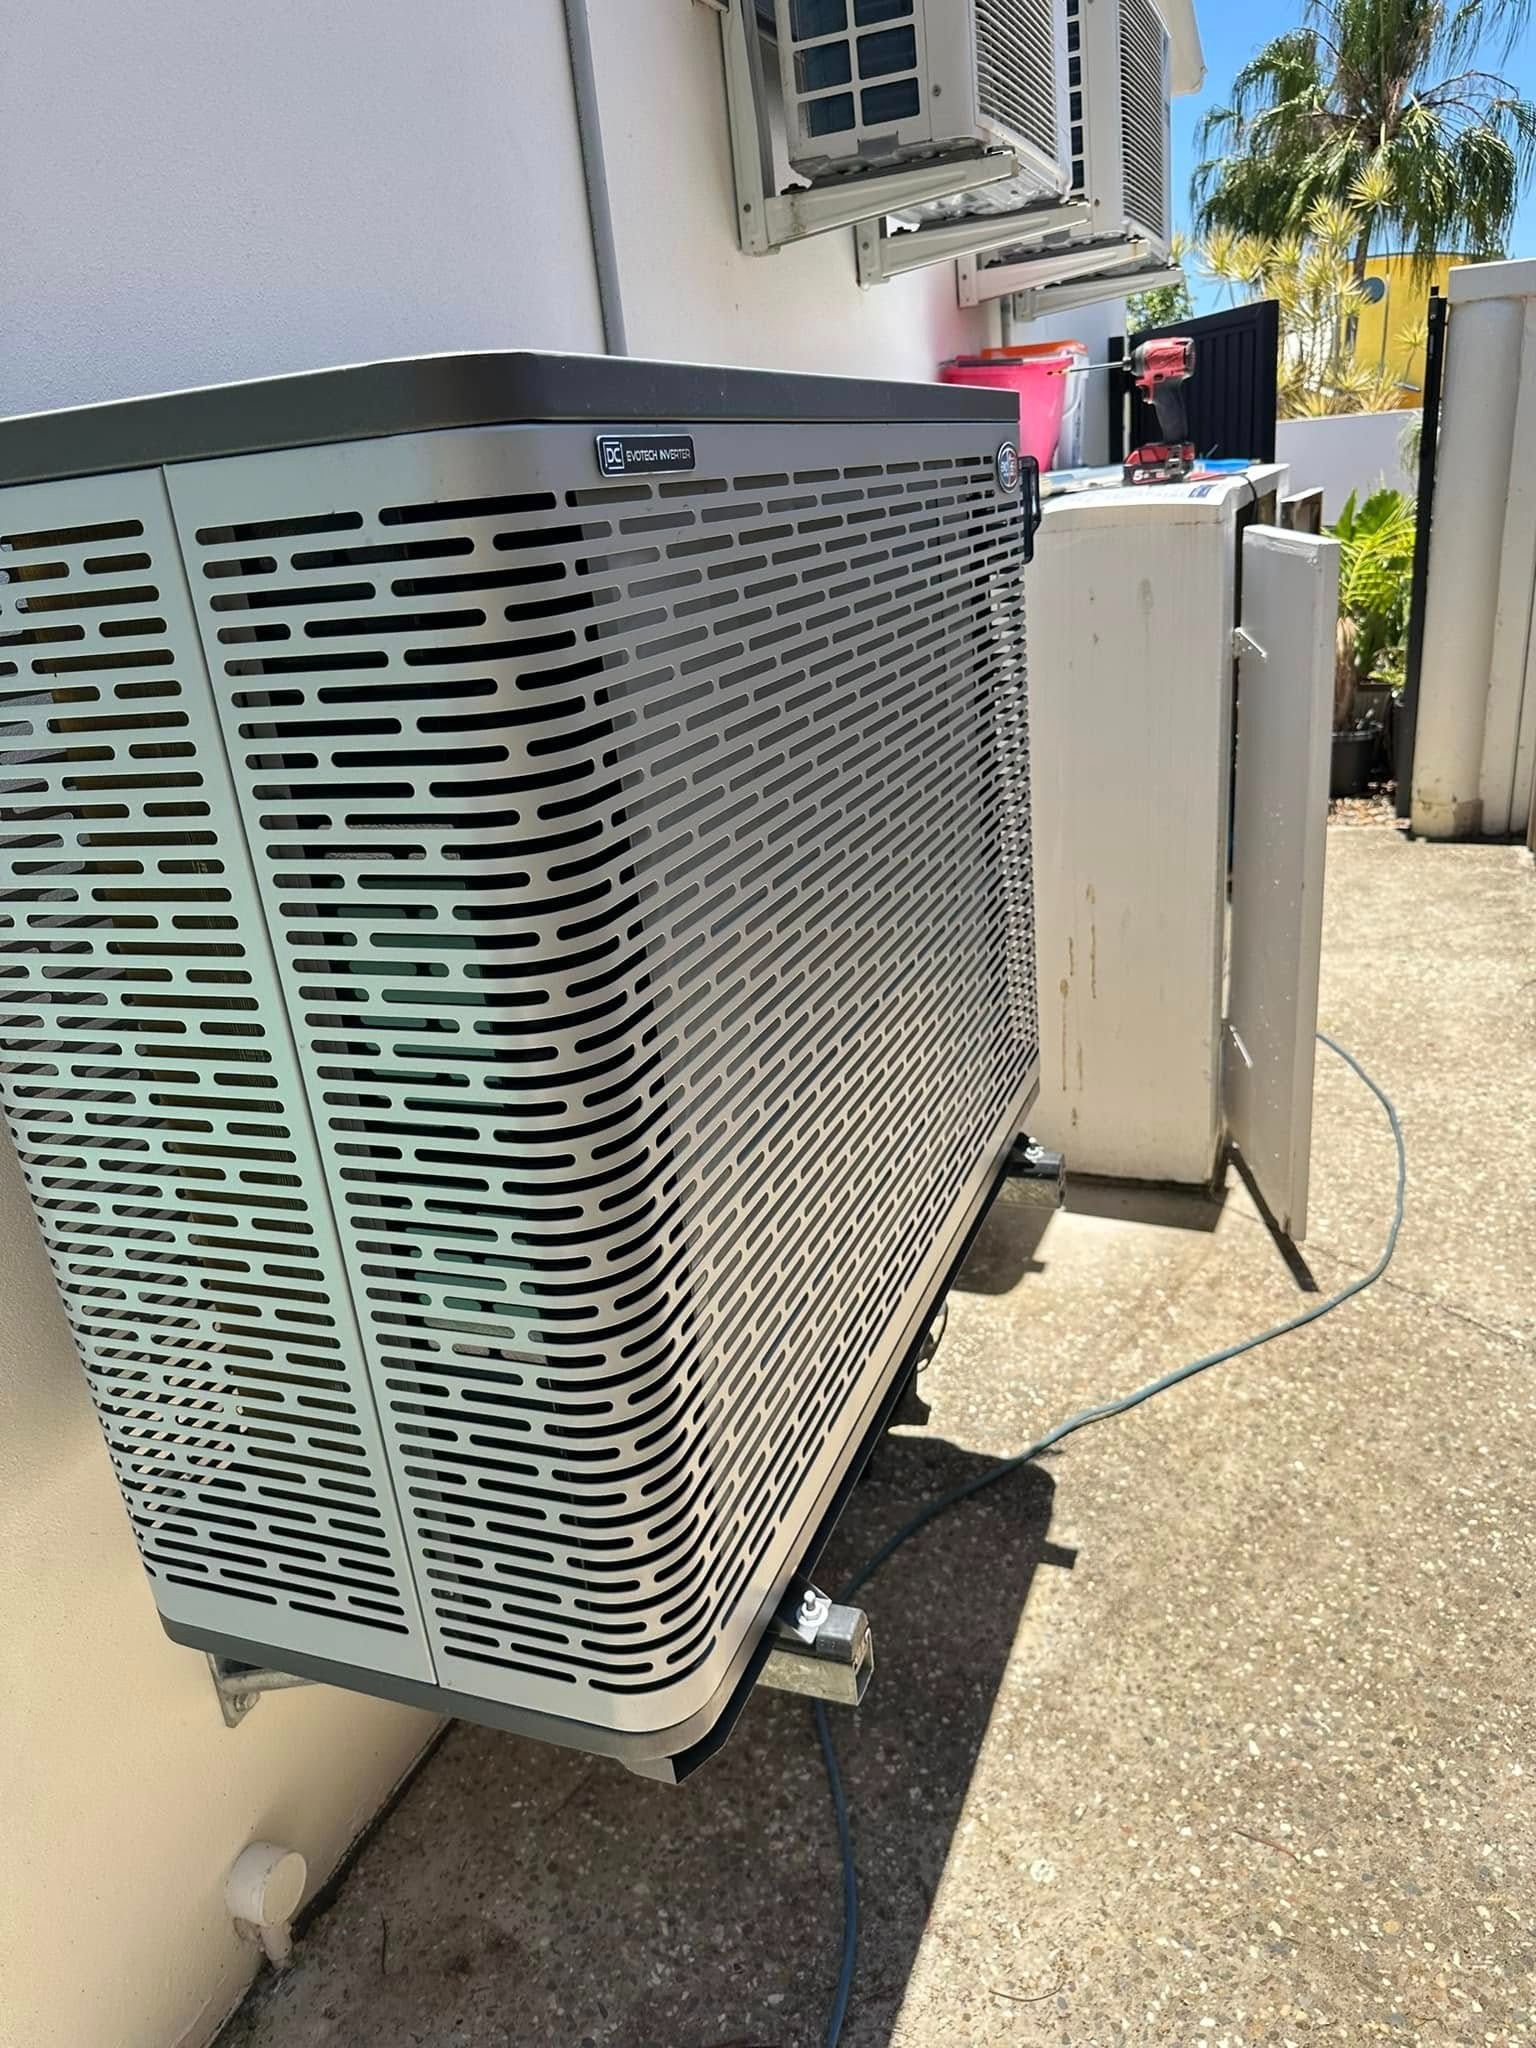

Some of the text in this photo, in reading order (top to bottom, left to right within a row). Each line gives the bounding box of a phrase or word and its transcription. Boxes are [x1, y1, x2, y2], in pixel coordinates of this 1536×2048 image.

[606, 447, 691, 463] DC EVOTECH INVERTER
